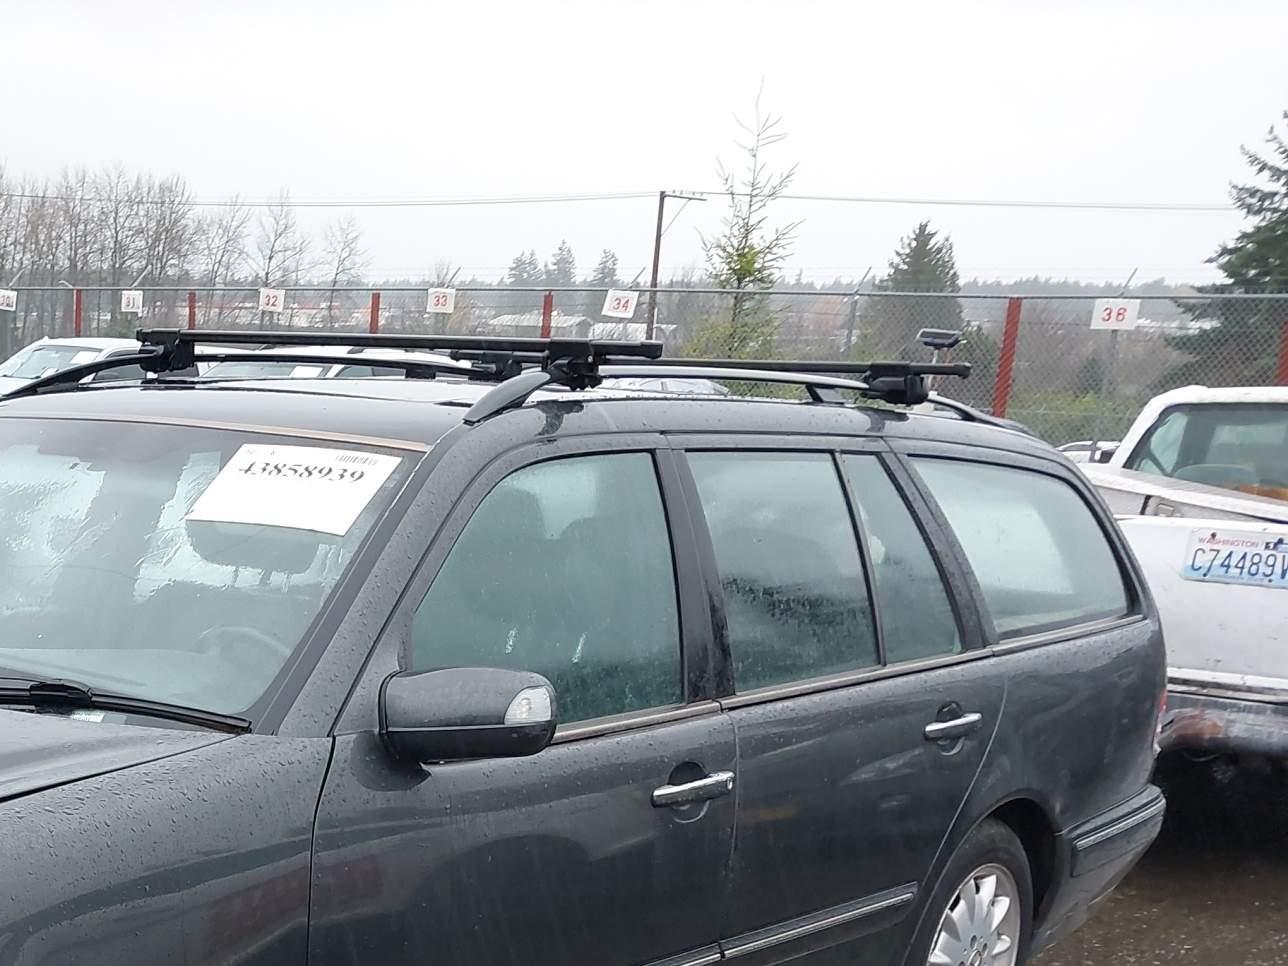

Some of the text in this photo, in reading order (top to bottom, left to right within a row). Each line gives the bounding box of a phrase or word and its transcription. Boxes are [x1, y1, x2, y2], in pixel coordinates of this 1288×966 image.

[264, 295, 279, 307] 32
[433, 295, 448, 307] 33
[613, 297, 630, 312] 34
[1101, 307, 1128, 322] 36
[238, 461, 365, 482] 43858939
